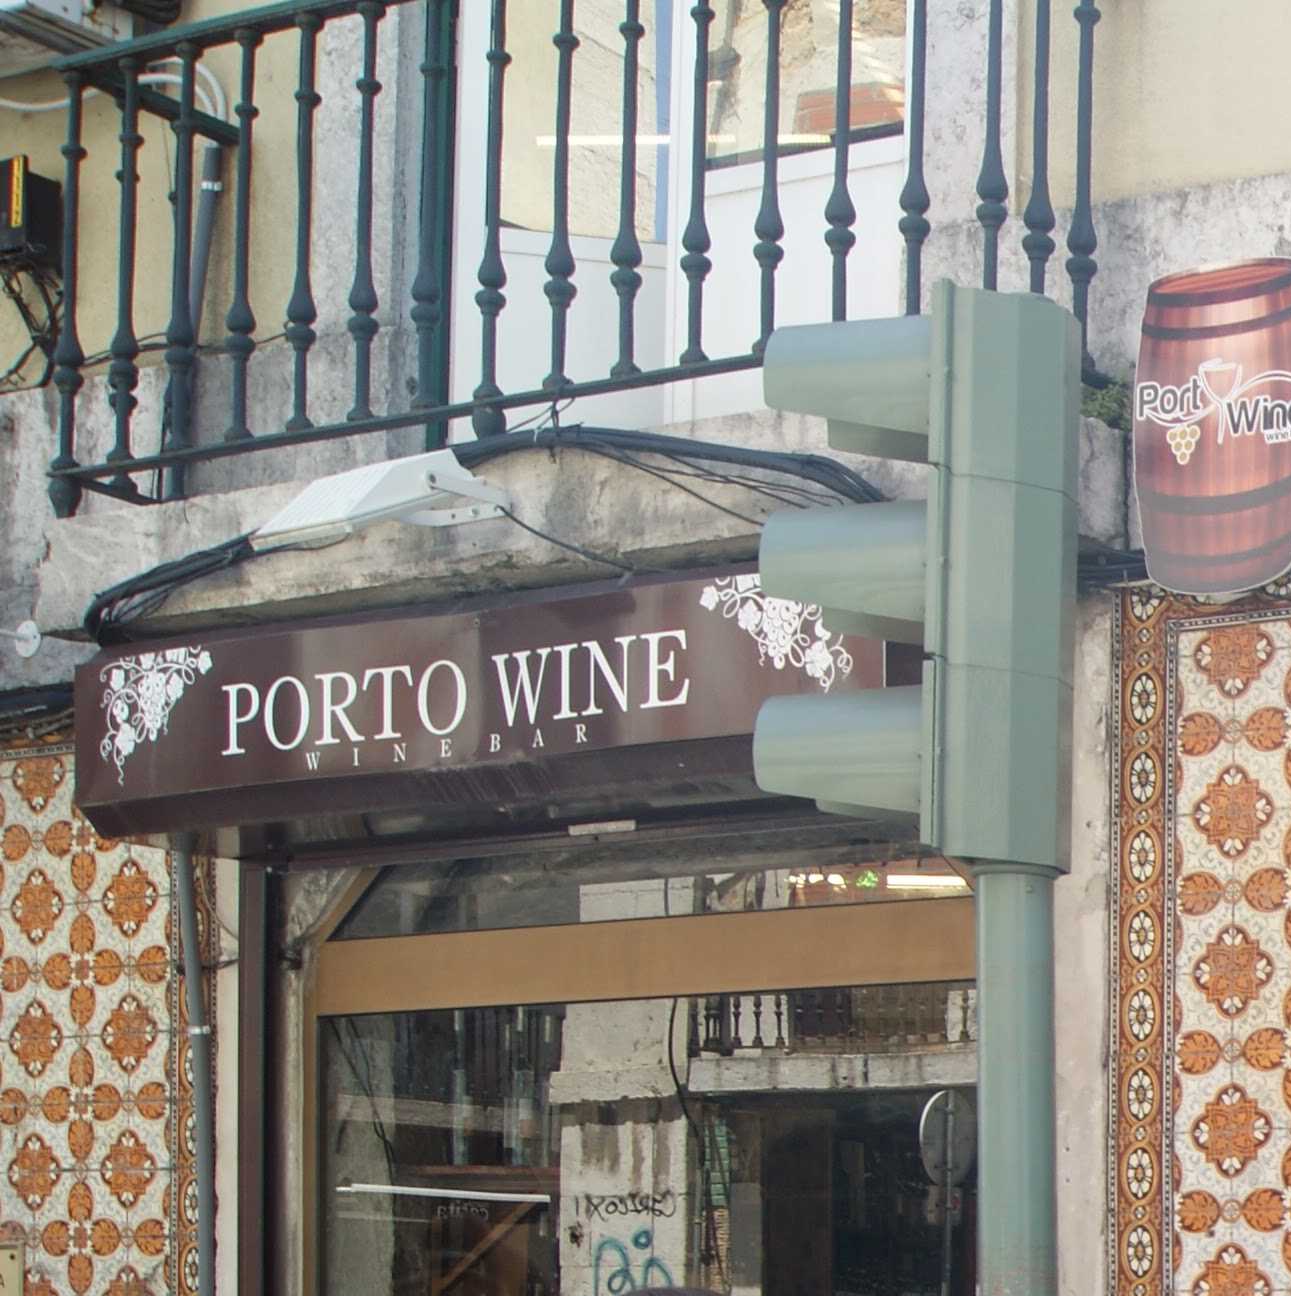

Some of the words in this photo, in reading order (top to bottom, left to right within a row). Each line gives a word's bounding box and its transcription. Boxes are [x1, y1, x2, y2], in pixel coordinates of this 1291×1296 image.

[1138, 376, 1201, 419] Port
[221, 659, 467, 756] PORTO
[491, 629, 690, 728] WINE
